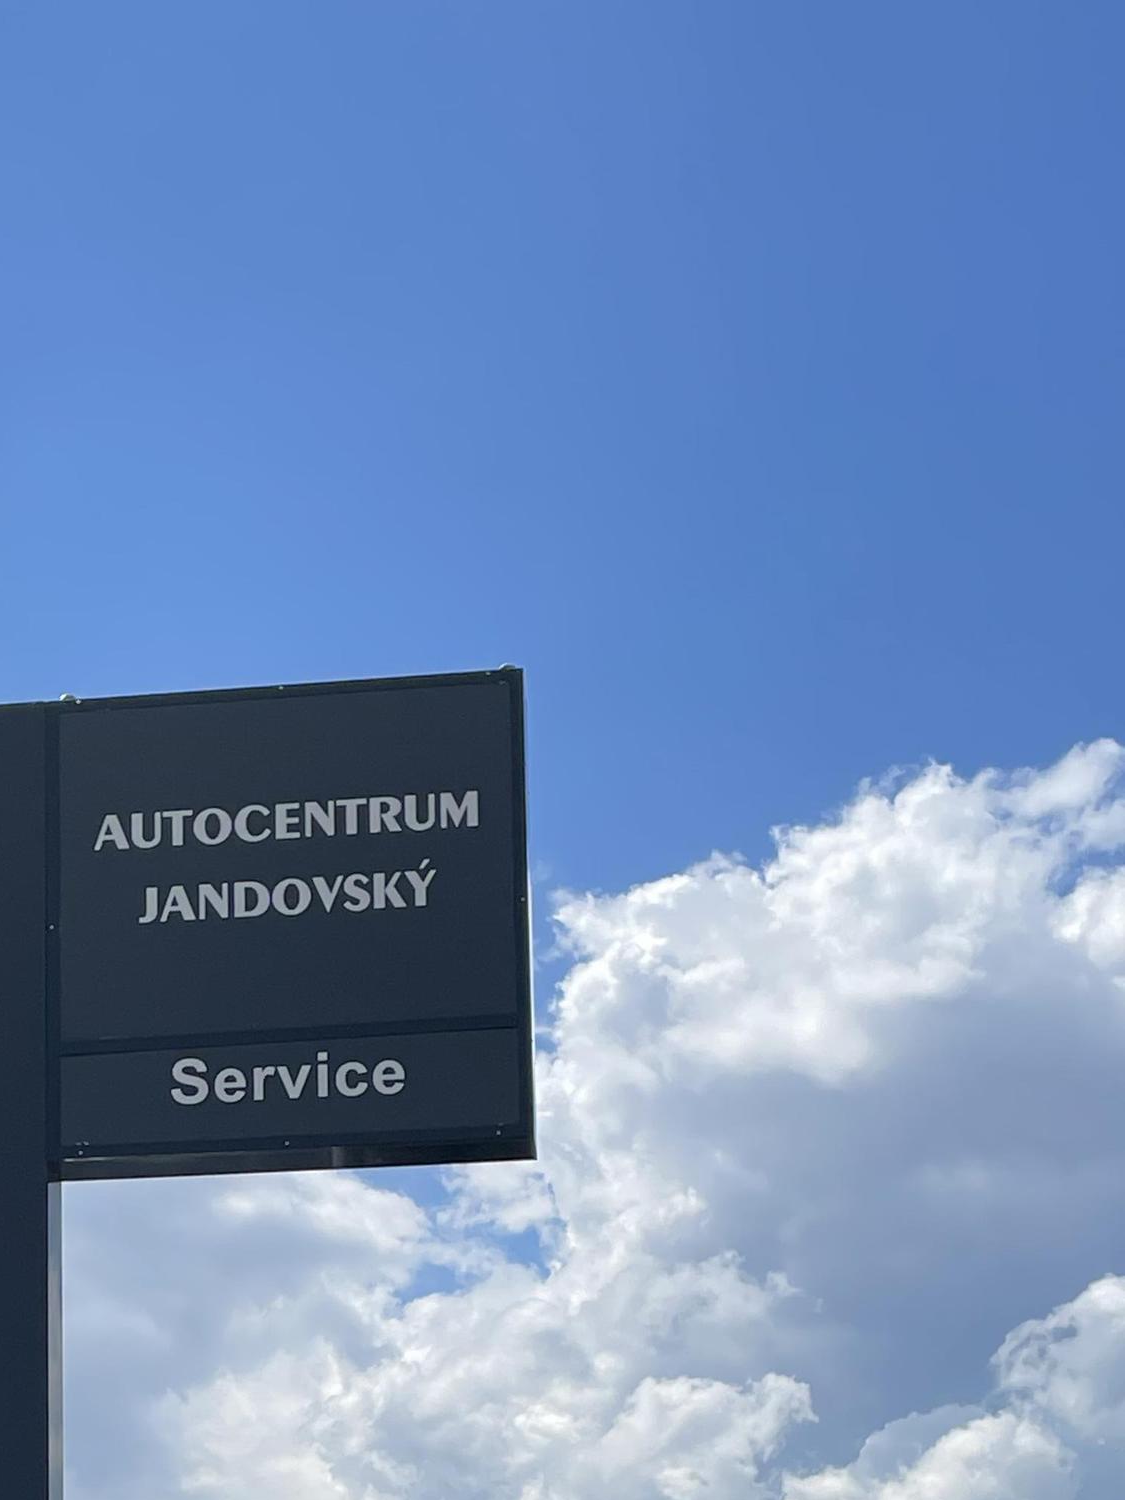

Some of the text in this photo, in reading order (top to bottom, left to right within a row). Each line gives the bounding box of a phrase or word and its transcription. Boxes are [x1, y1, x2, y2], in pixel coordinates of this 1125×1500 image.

[93, 790, 480, 852] AUTOCENTRUM
[138, 858, 437, 924] JANDOVSKÝ
[170, 1051, 406, 1105] Service
